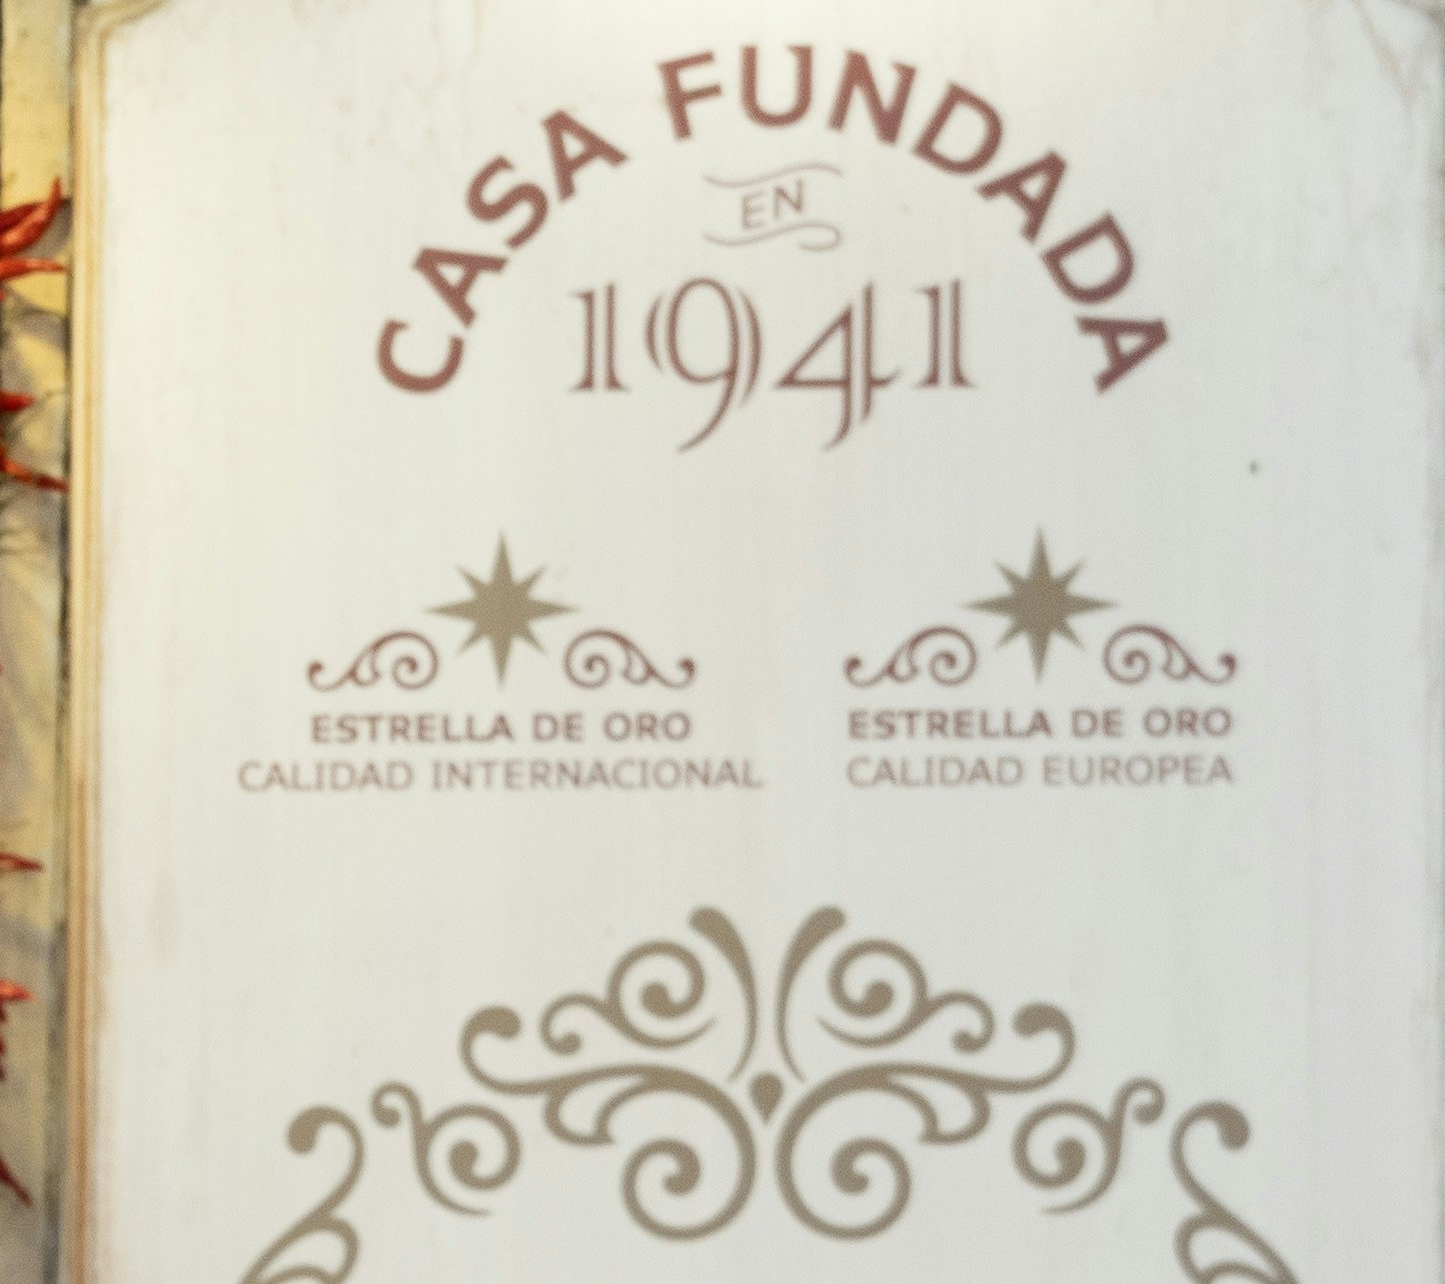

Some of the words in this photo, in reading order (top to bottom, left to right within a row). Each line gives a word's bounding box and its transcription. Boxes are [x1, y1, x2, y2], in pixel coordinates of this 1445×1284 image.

[374, 104, 630, 396] CASA
[655, 43, 1170, 394] FUNDADA
[738, 178, 808, 231] EN
[569, 275, 978, 452] 1941
[311, 712, 514, 744] ESTRELLA
[532, 712, 588, 744] DE
[603, 711, 693, 743] ORO
[848, 708, 1053, 741] ESTRELLA
[1070, 708, 1126, 740] DE
[1142, 707, 1234, 739] ORO
[237, 761, 415, 793] CALIDAD
[432, 758, 765, 792] INTERNACIONAL
[846, 756, 1025, 788] CALIDAD
[1042, 753, 1234, 787] EUROPEA
